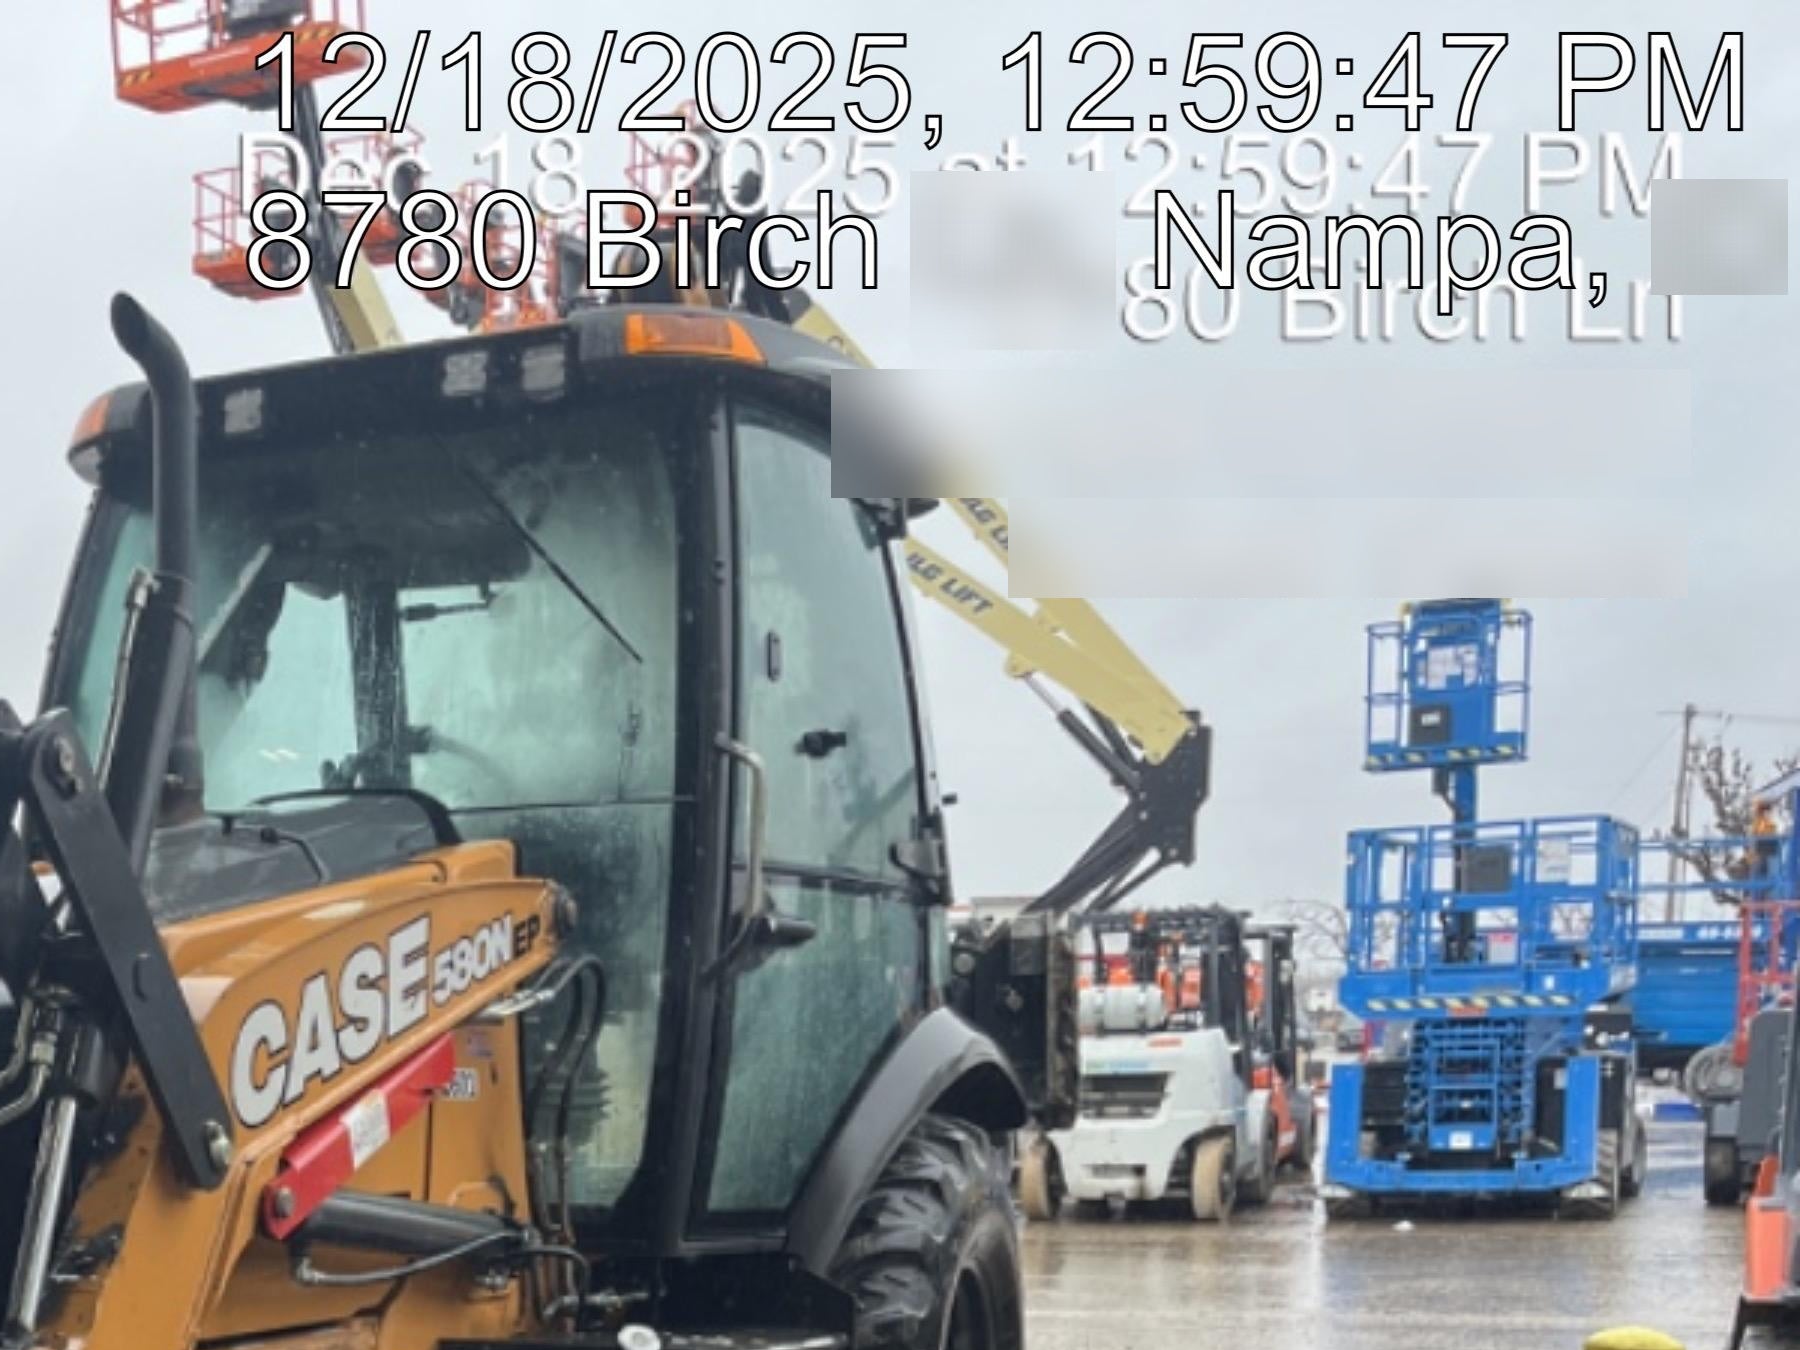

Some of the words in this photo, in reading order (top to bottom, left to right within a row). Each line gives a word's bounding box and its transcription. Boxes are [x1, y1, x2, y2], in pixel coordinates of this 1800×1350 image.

[231, 912, 432, 1129] CASE
[432, 912, 514, 1007] 580N
[513, 913, 541, 959] EP
